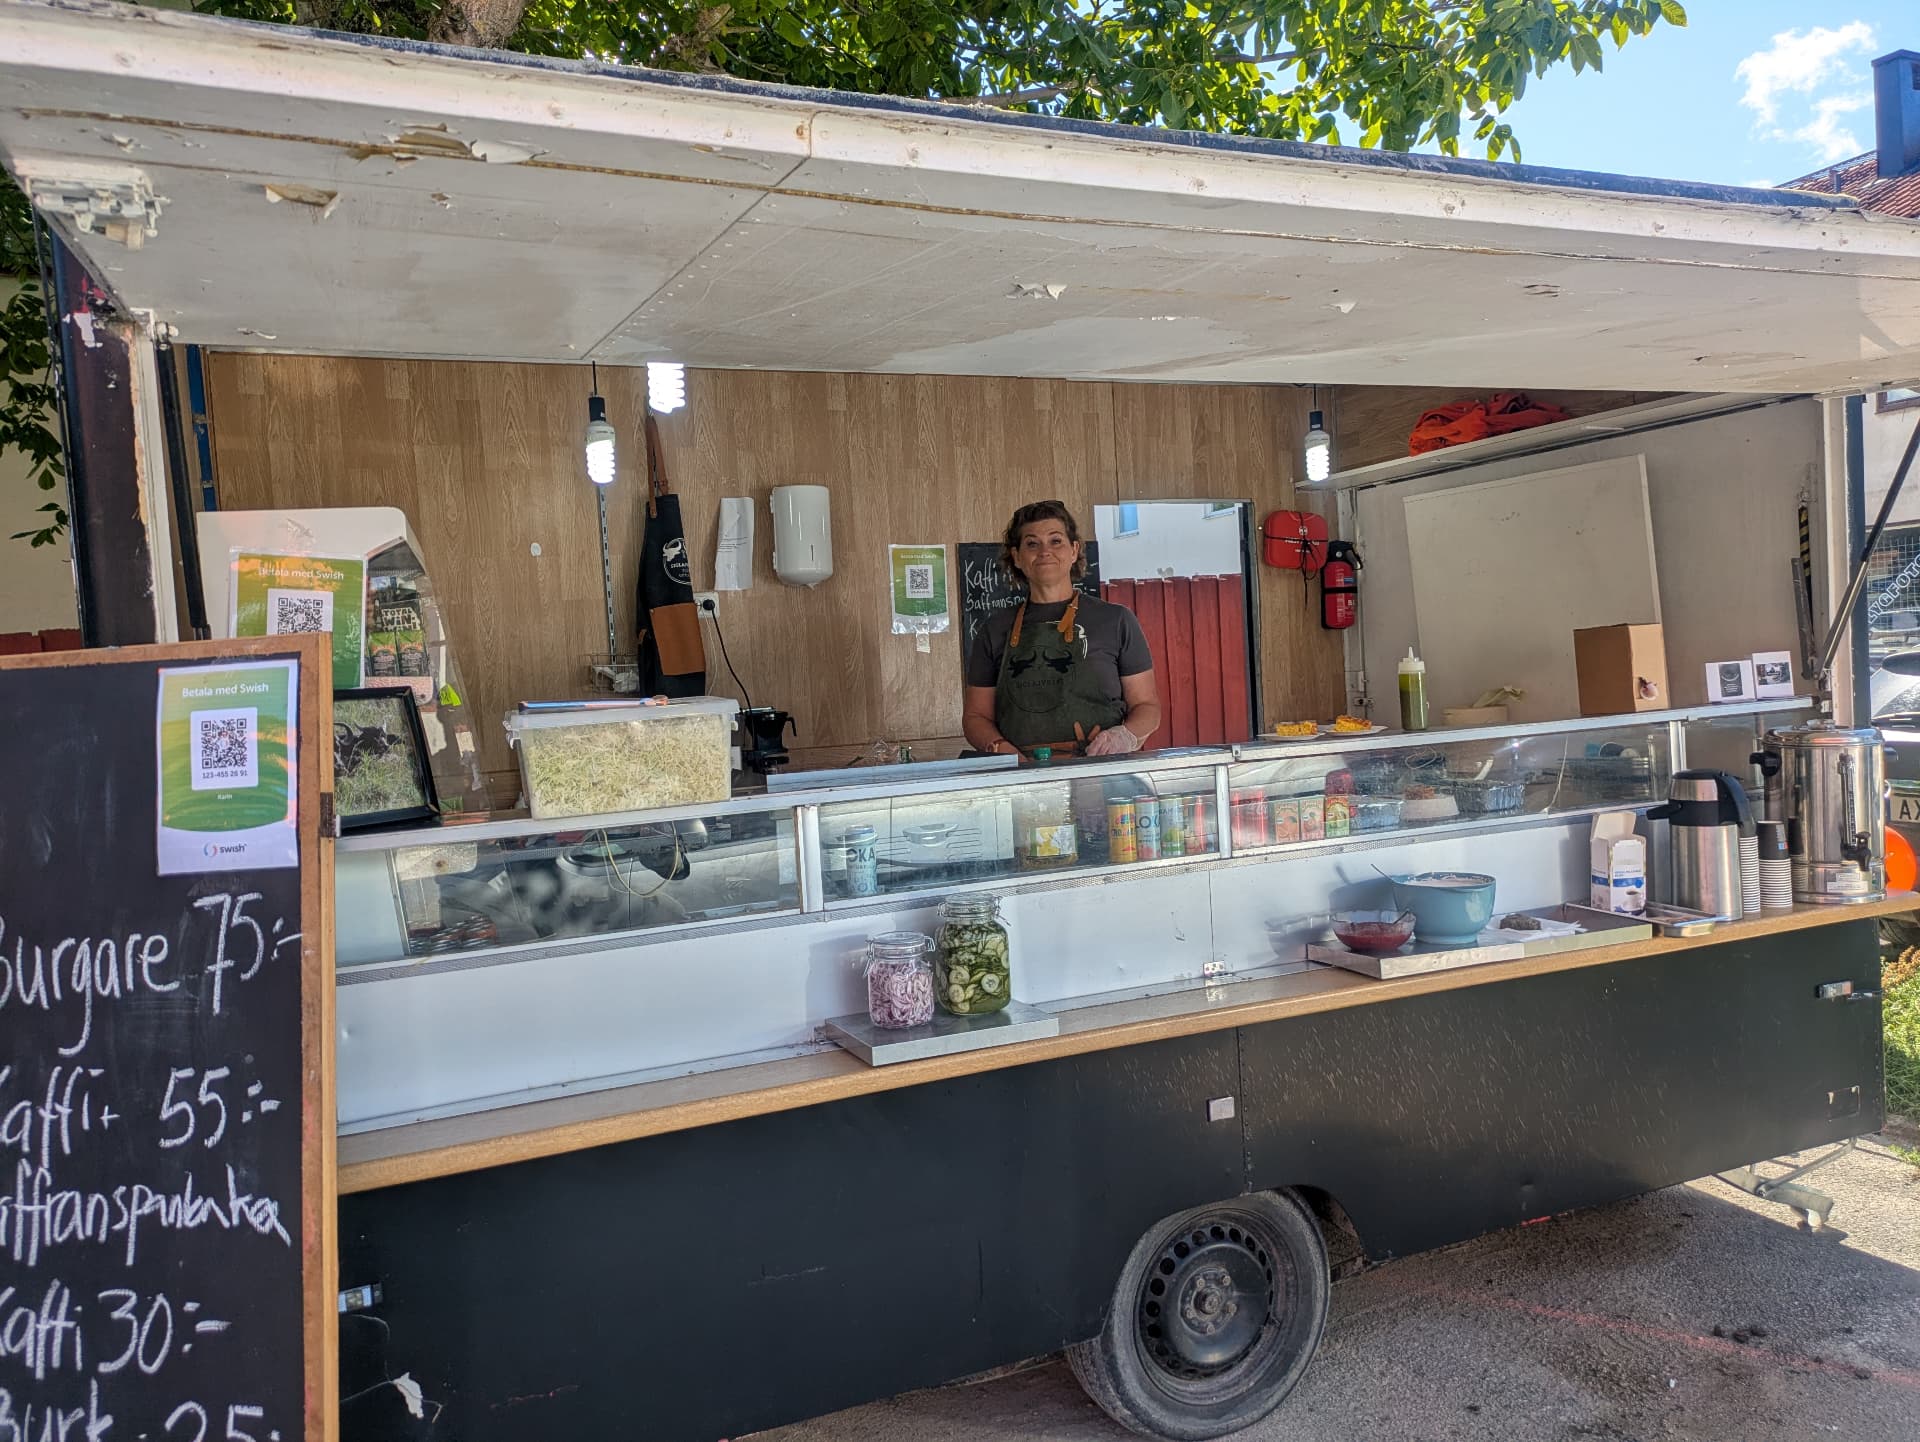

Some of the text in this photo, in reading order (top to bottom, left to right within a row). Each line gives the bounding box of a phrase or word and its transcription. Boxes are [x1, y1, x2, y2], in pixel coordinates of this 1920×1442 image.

[316, 571, 344, 580] Swish
[965, 558, 999, 593] Kaffi
[182, 682, 269, 698] Betala med Swish
[220, 843, 245, 854] swish
[158, 1066, 281, 1148] 55:-
[0, 1278, 233, 1380] affi 30:-
